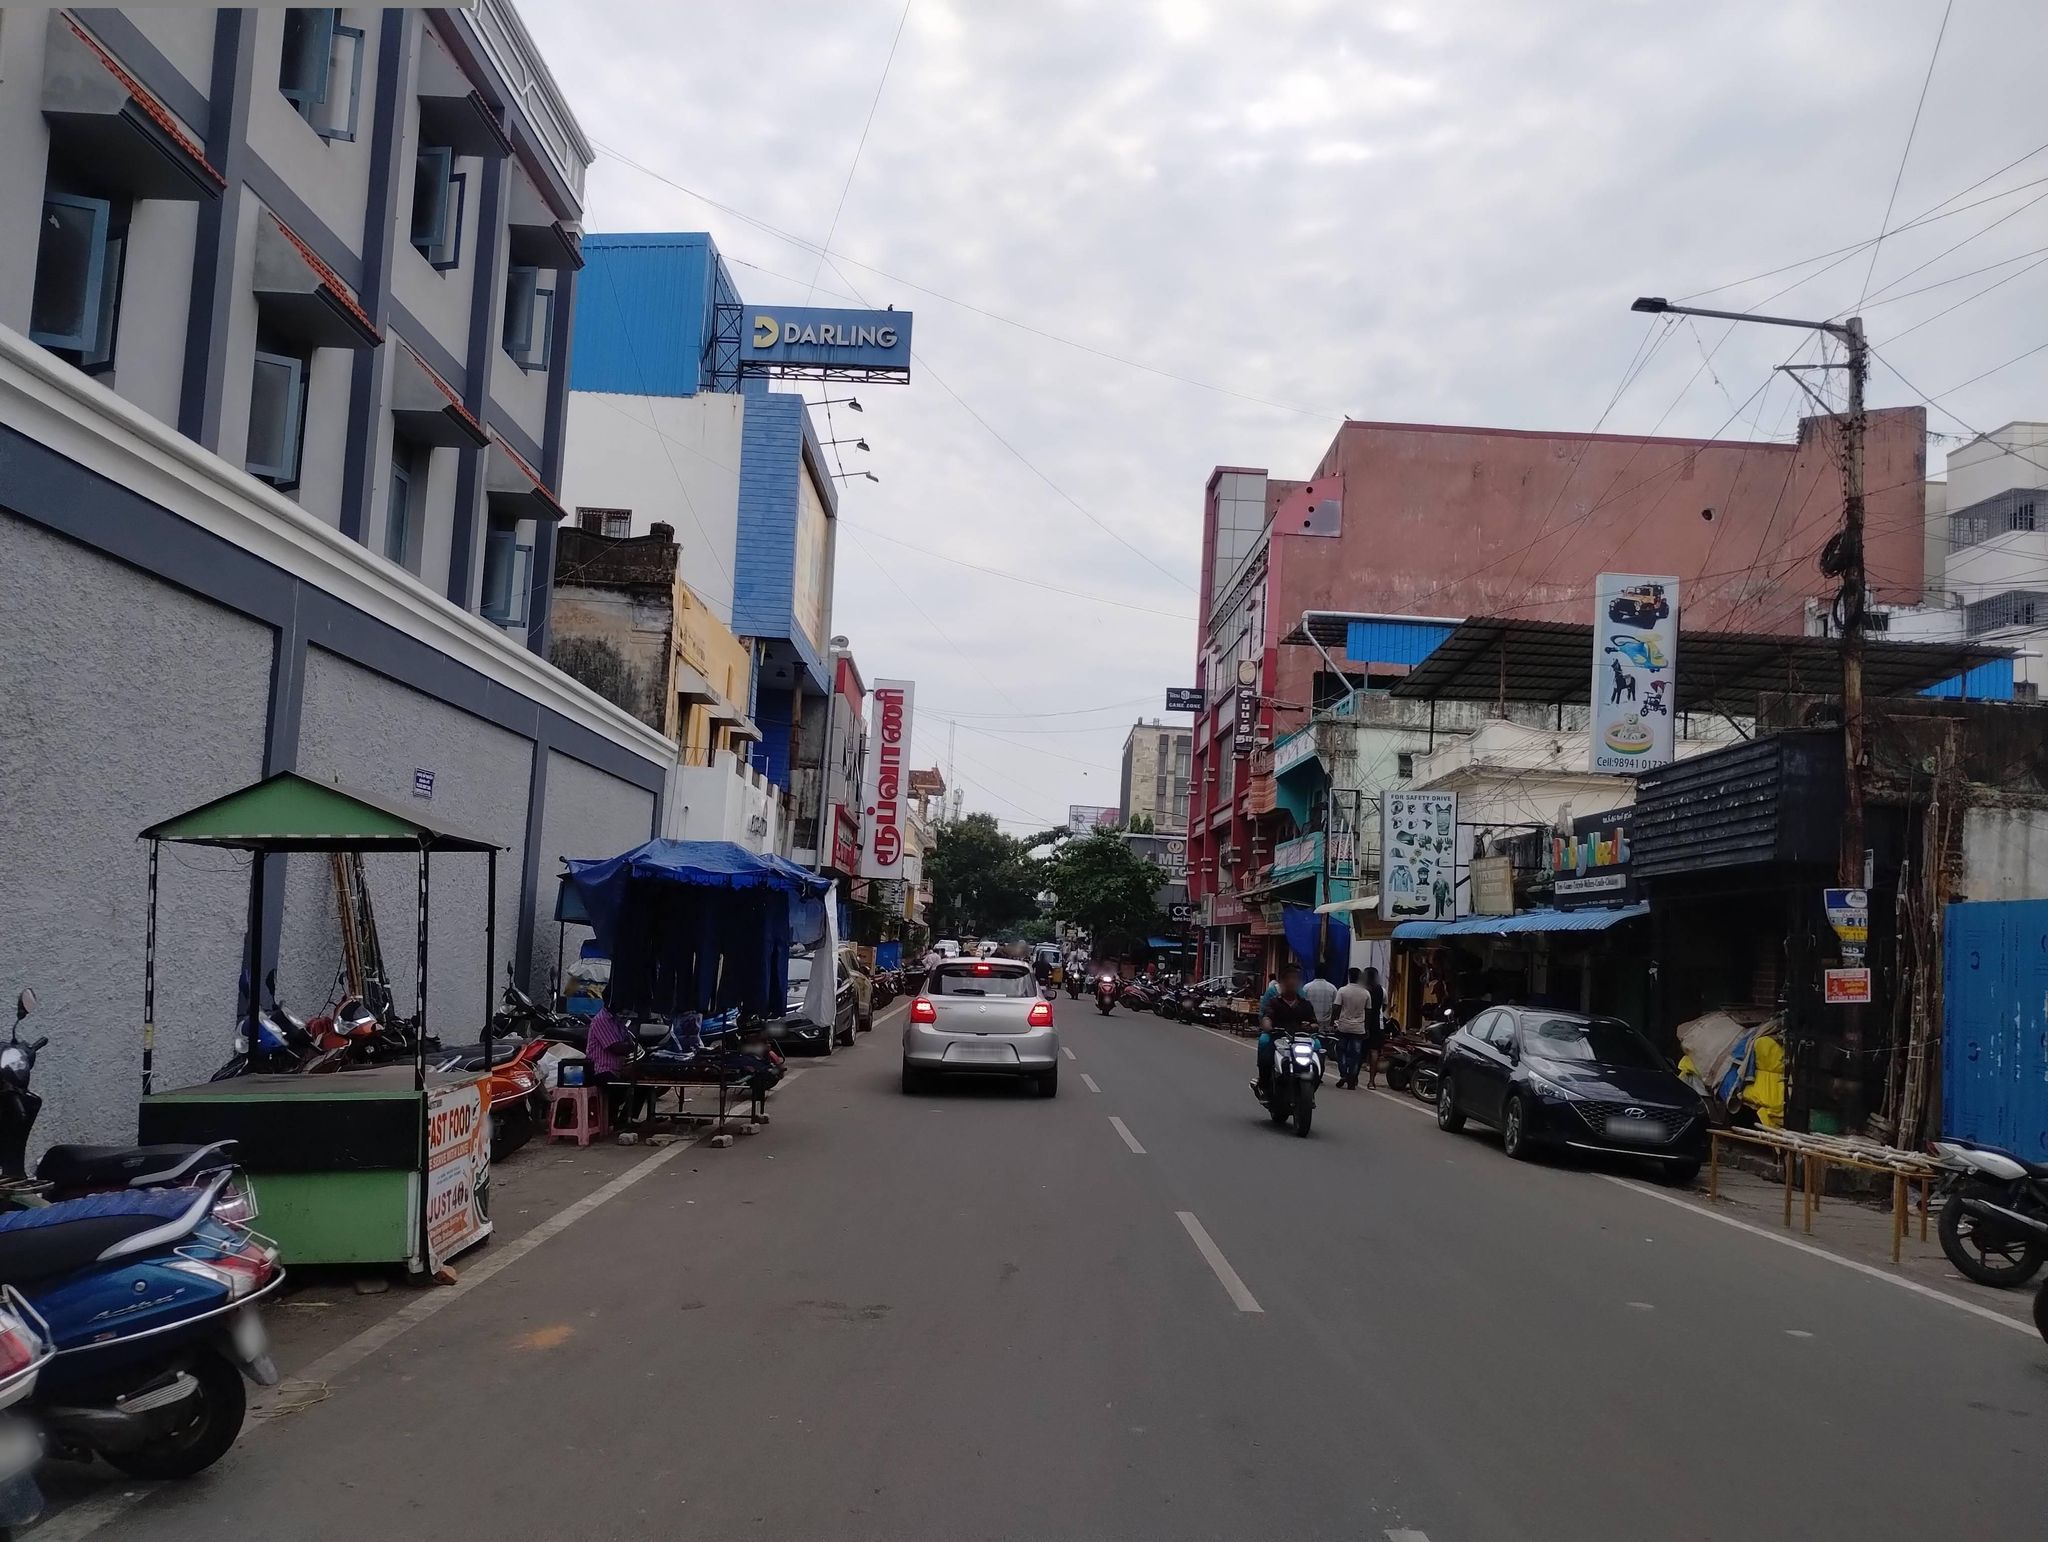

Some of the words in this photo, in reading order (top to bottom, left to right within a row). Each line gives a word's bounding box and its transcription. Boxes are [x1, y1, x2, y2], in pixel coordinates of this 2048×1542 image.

[784, 322, 898, 348] DARLING
[449, 1104, 471, 1141] FOOD
[428, 1188, 452, 1223] JUST
